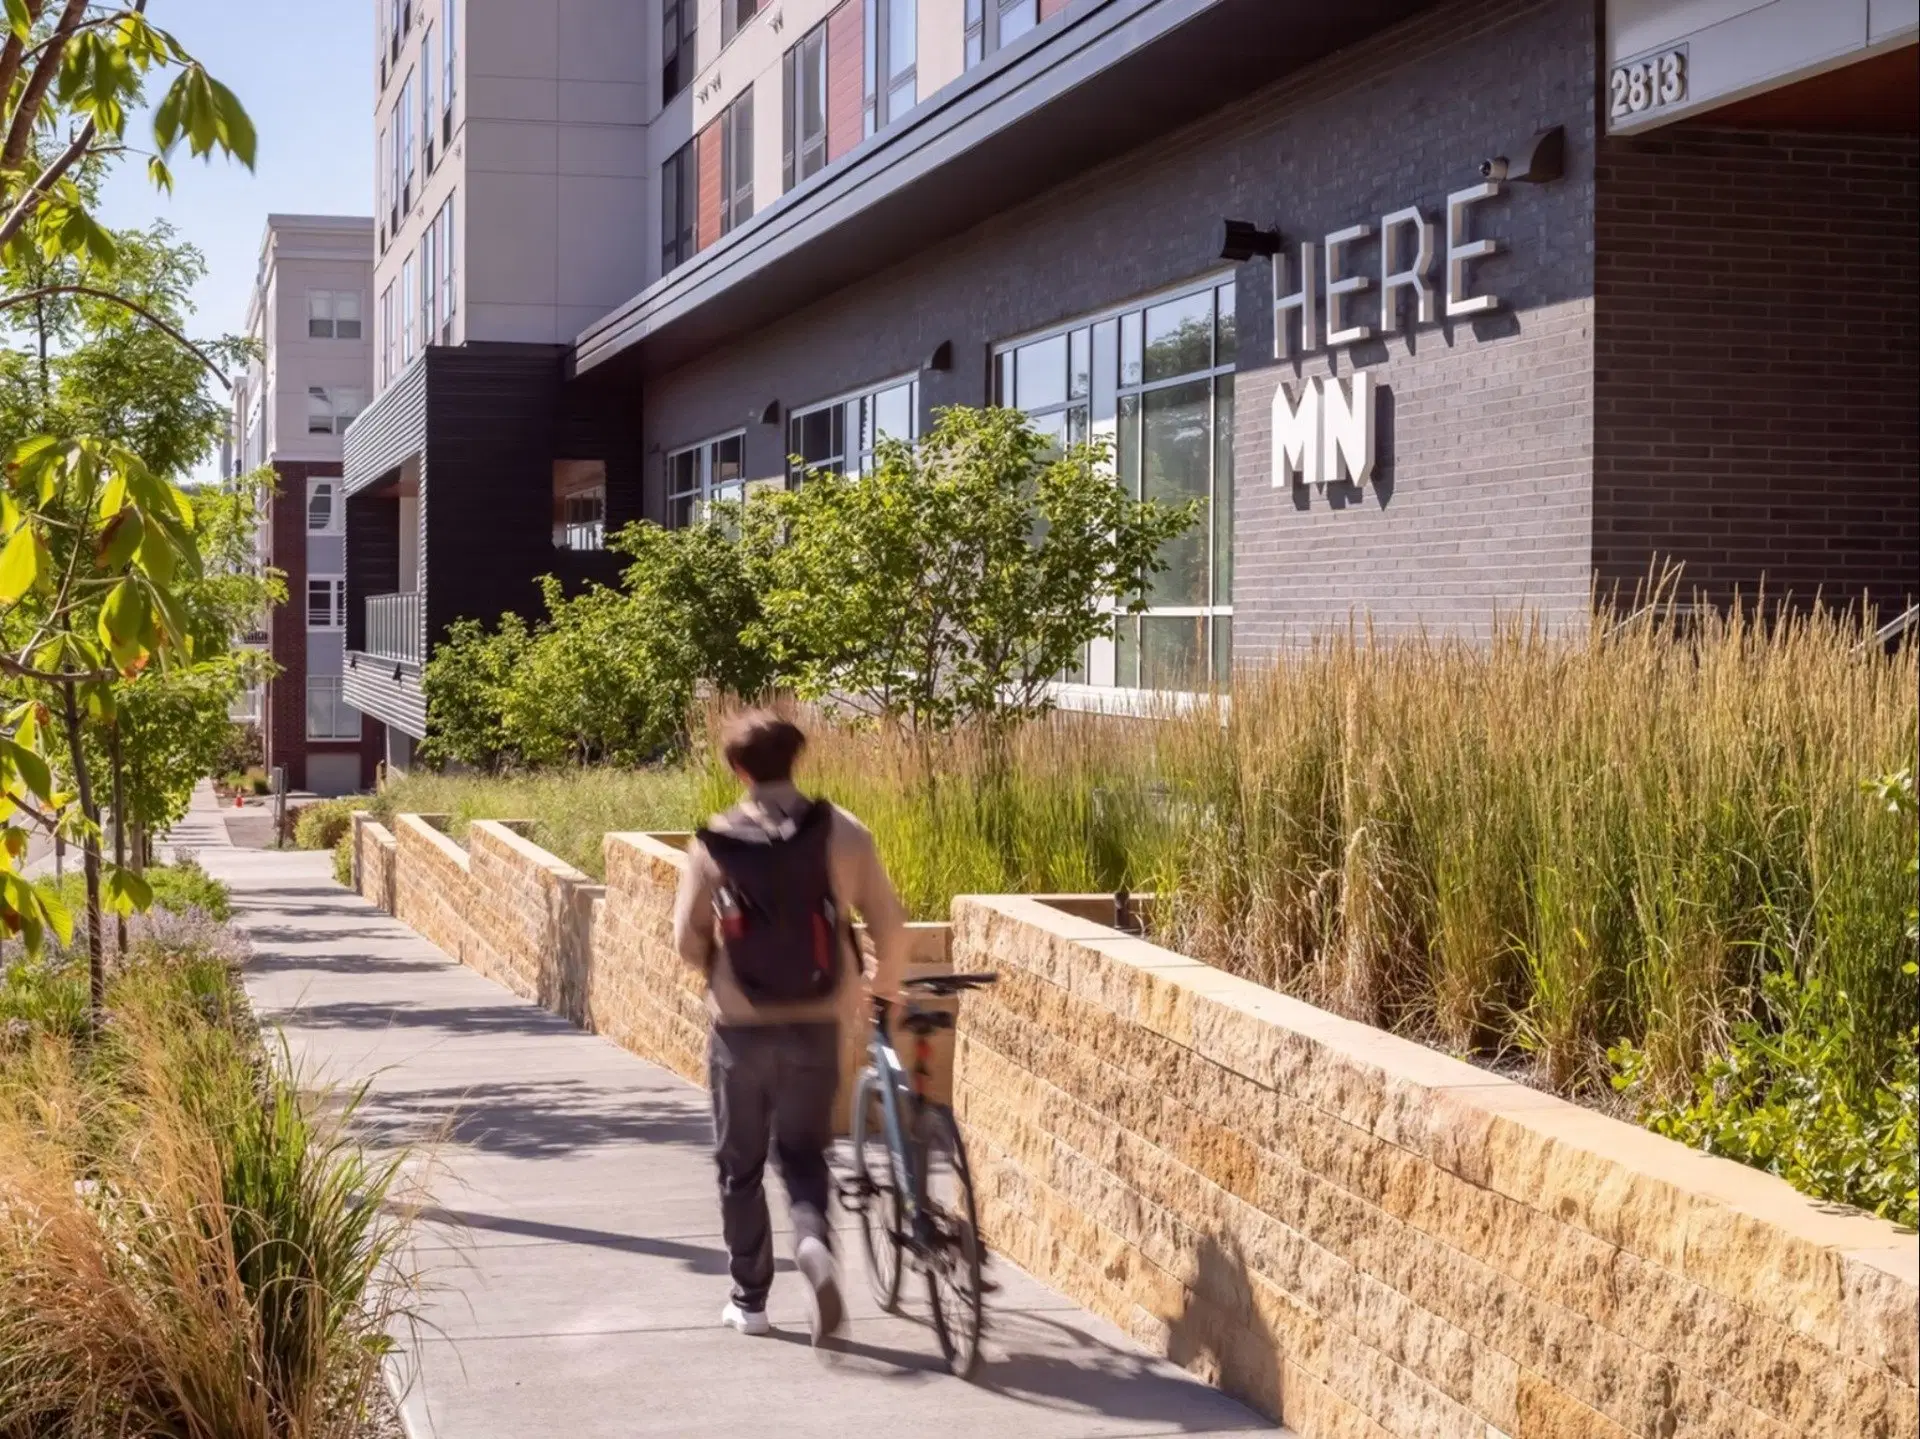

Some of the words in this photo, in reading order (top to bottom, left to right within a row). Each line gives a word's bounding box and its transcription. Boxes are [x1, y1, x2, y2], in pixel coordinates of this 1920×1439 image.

[1611, 53, 1684, 117] 2813
[1273, 182, 1498, 359] HERE
[1272, 371, 1375, 488] MN
